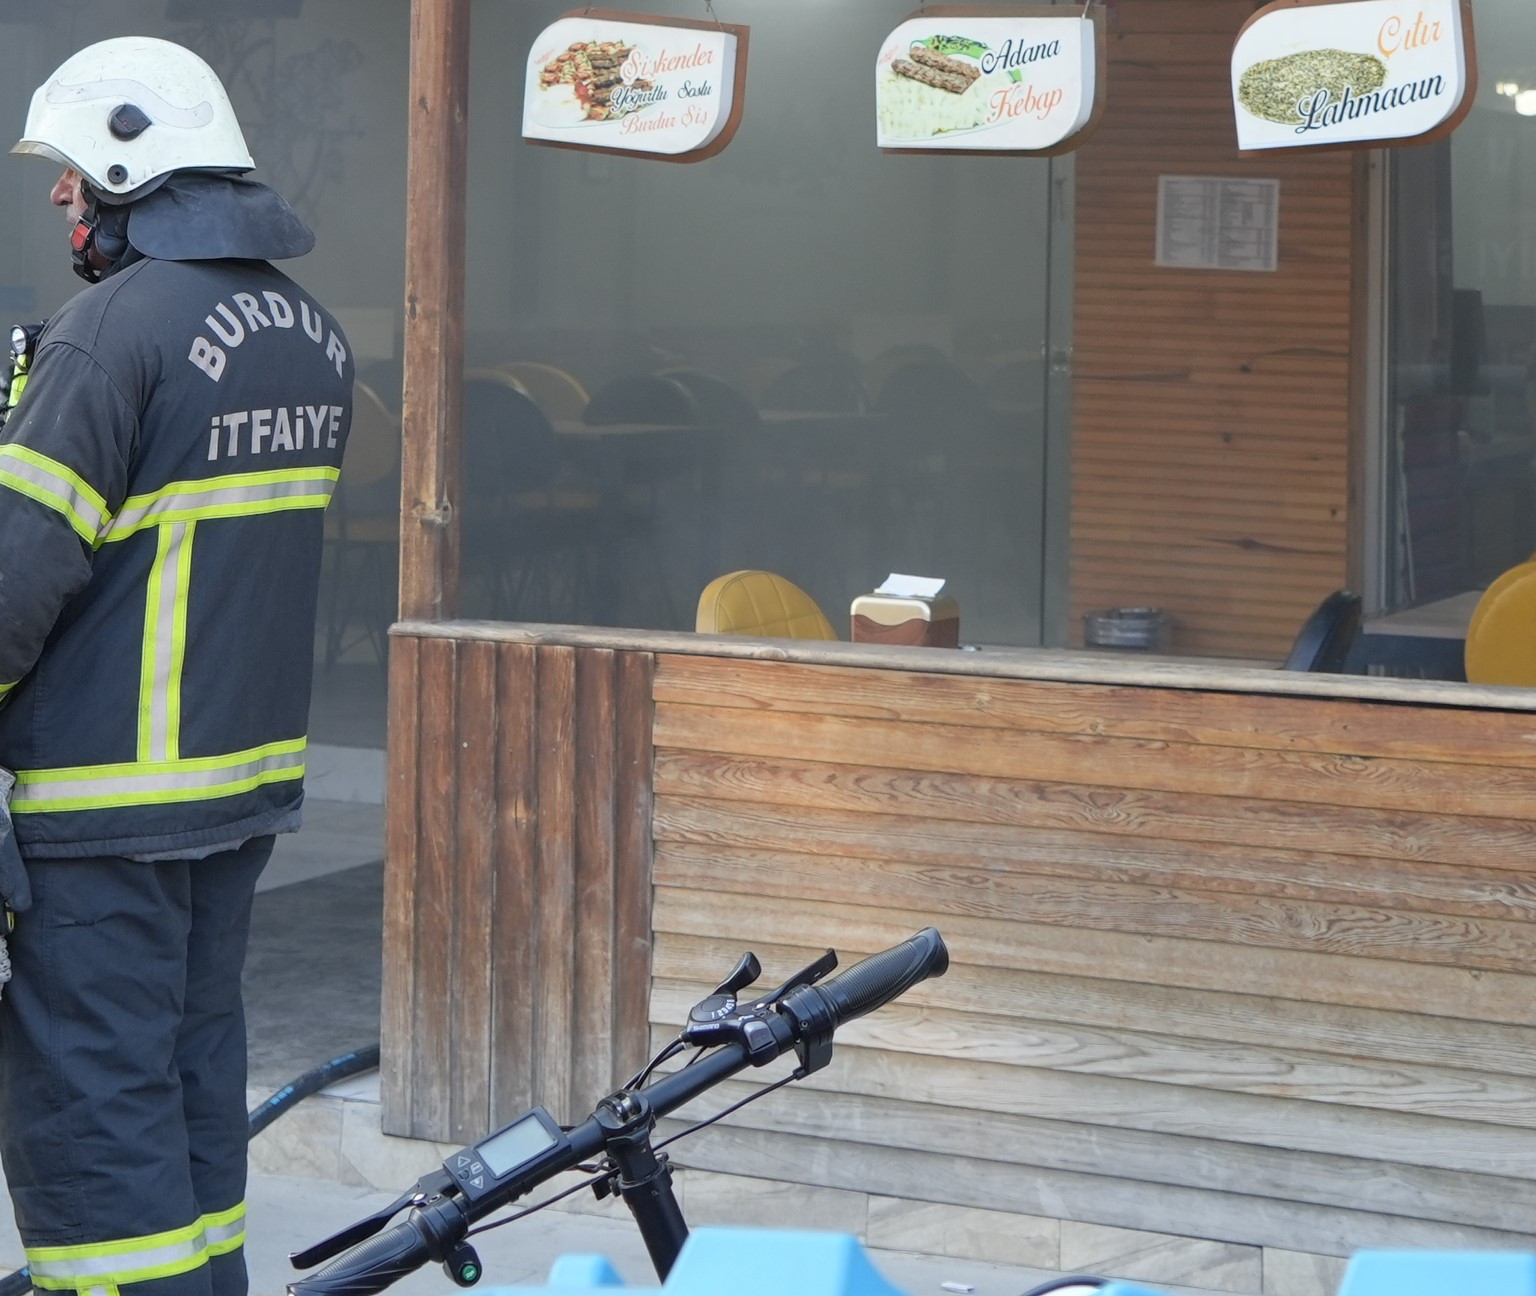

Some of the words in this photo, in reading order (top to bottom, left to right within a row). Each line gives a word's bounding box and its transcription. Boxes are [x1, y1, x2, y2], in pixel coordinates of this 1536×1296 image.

[1376, 10, 1441, 60] Çıtır
[981, 38, 1060, 74] Adana
[611, 84, 668, 112] Yoğurtlu
[678, 80, 712, 99] Soslu
[987, 84, 1063, 123] Kebap
[1295, 72, 1445, 134] Lahmacun
[620, 110, 677, 135] Burdur
[187, 290, 349, 382] BURDUR
